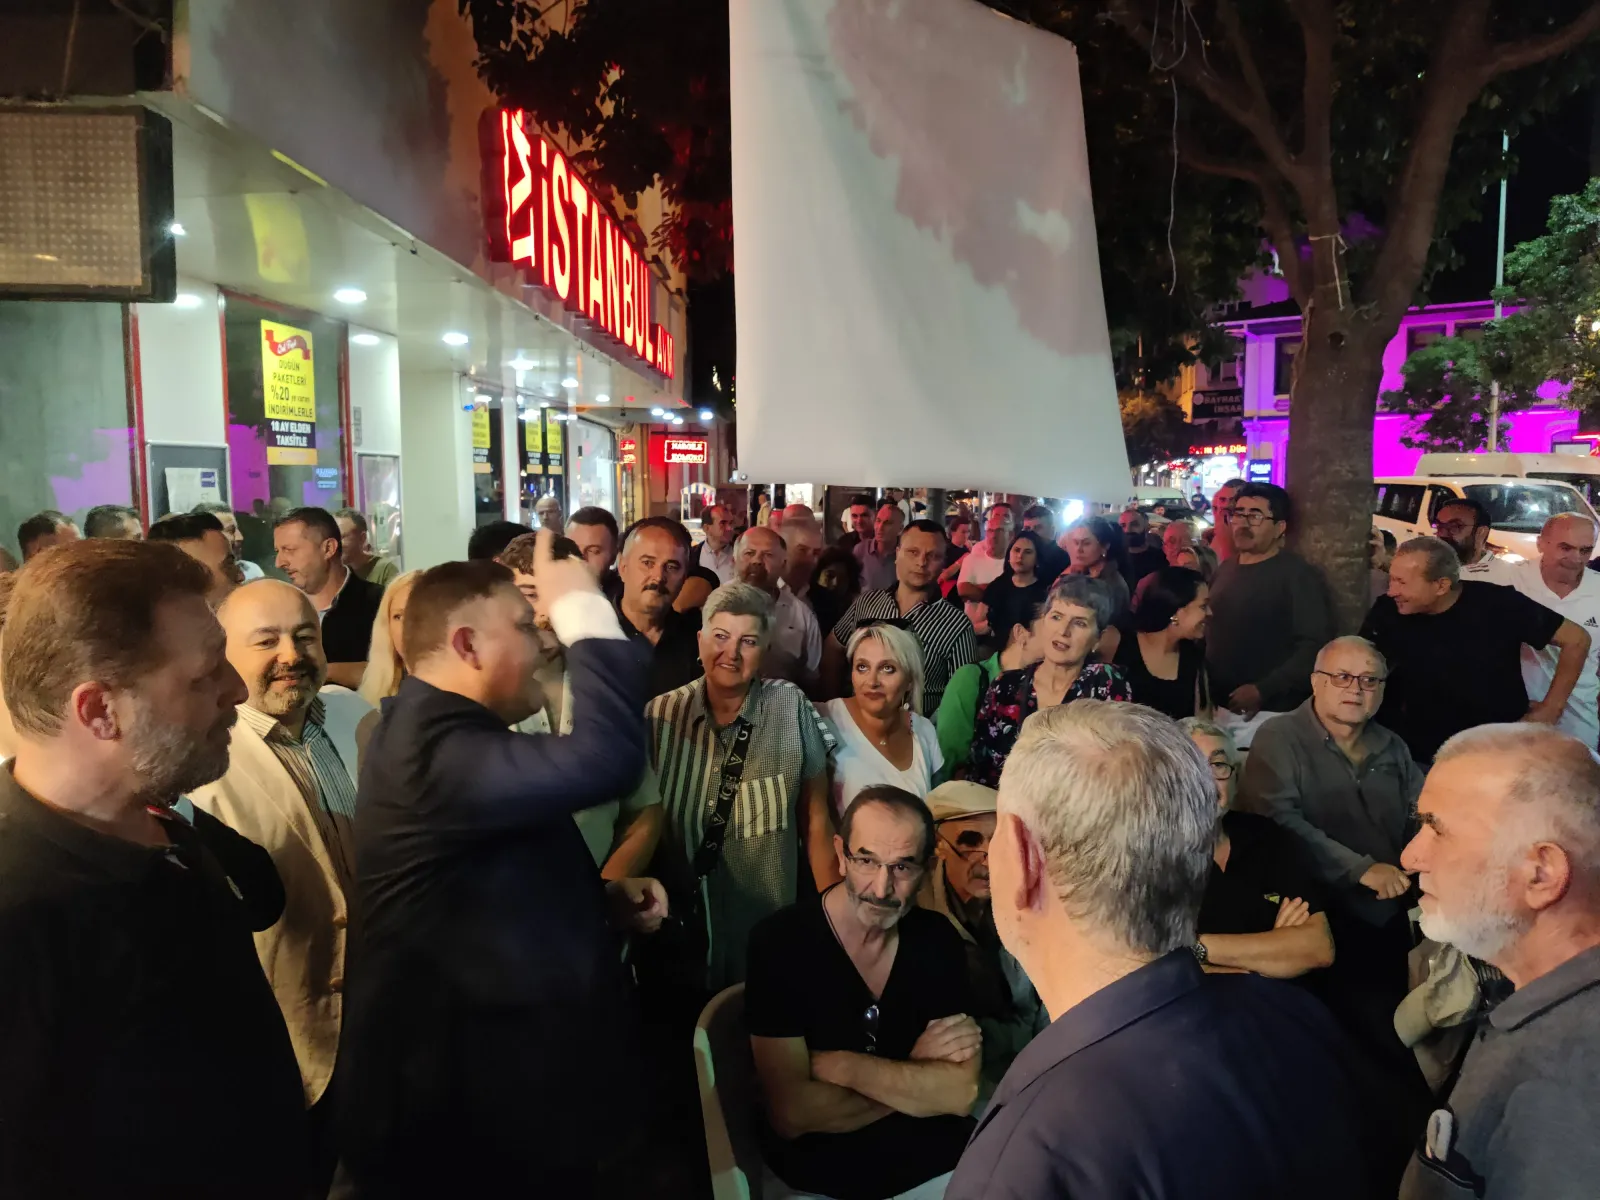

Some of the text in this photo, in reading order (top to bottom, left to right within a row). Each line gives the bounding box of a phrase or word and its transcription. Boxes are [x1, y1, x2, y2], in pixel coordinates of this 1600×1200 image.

[541, 139, 654, 364] İSTANBUL
[273, 372, 307, 386] PAKETLERİ
[271, 385, 289, 401] %20
[268, 401, 313, 418] İNDİRİMLERLE
[280, 422, 289, 432] AY
[290, 422, 311, 434] ELDEN
[276, 433, 308, 447] TAKSİTLE
